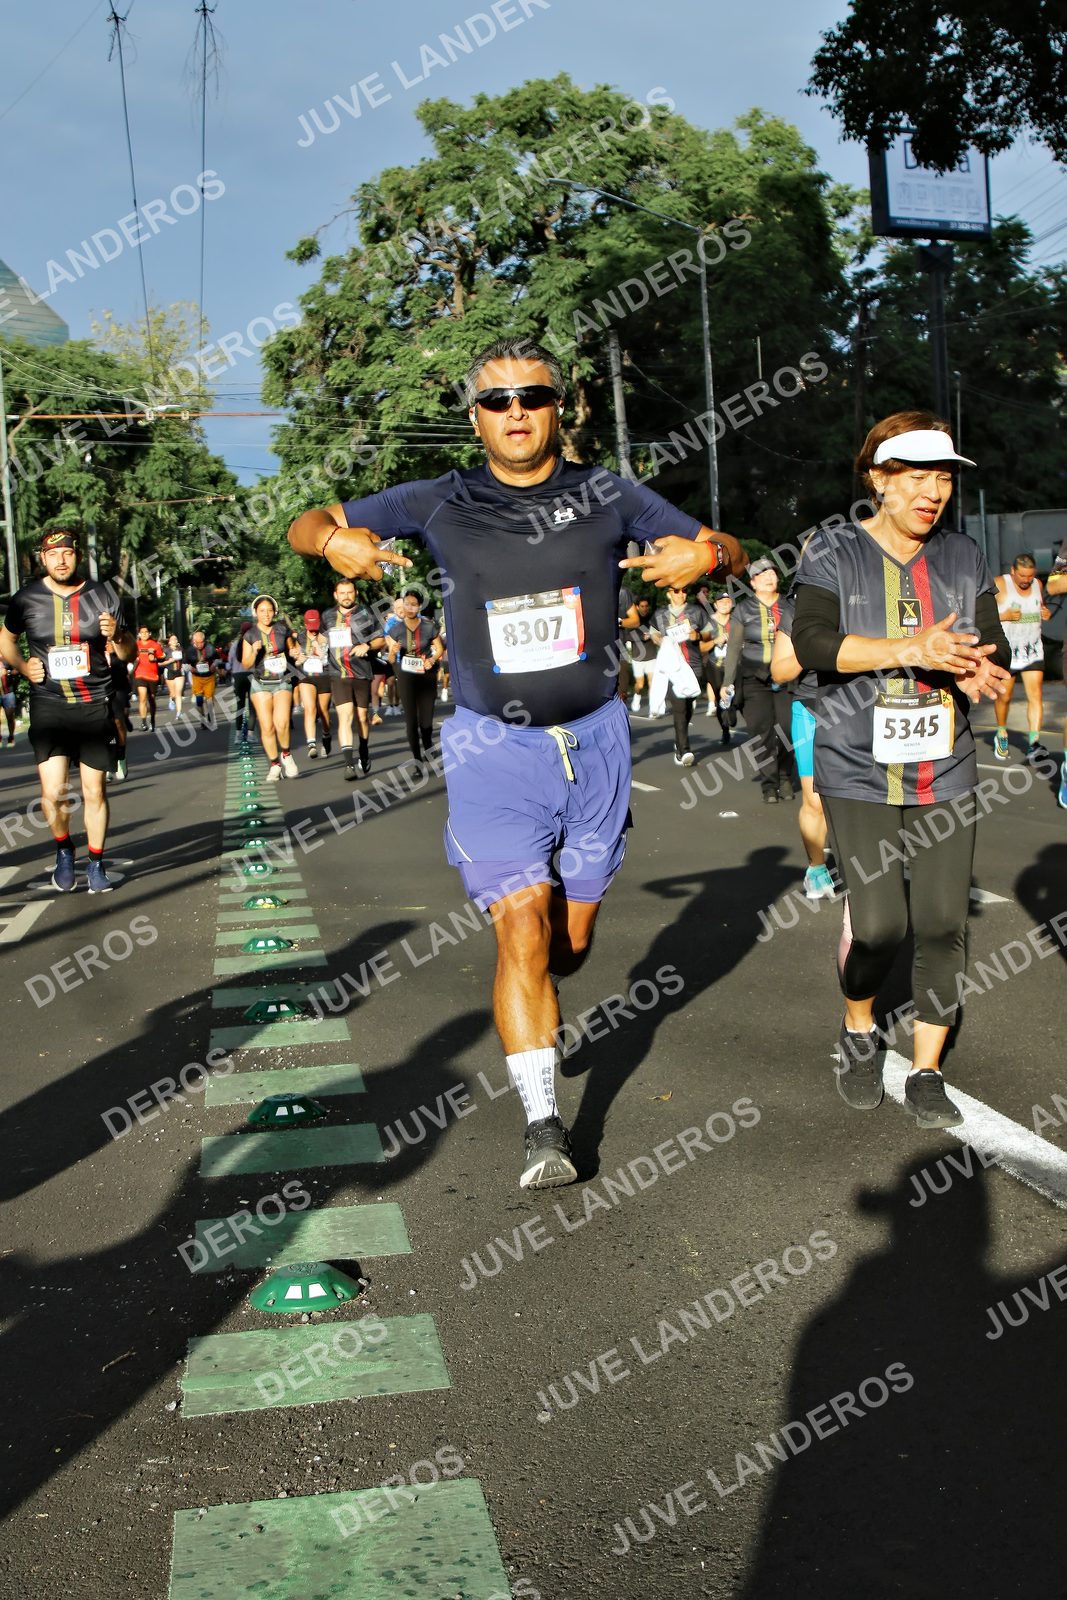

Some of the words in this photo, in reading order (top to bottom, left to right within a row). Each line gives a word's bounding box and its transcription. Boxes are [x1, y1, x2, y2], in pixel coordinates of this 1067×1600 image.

[503, 615, 563, 648] 8307
[54, 655, 82, 667] 8019
[883, 714, 939, 740] 5345
